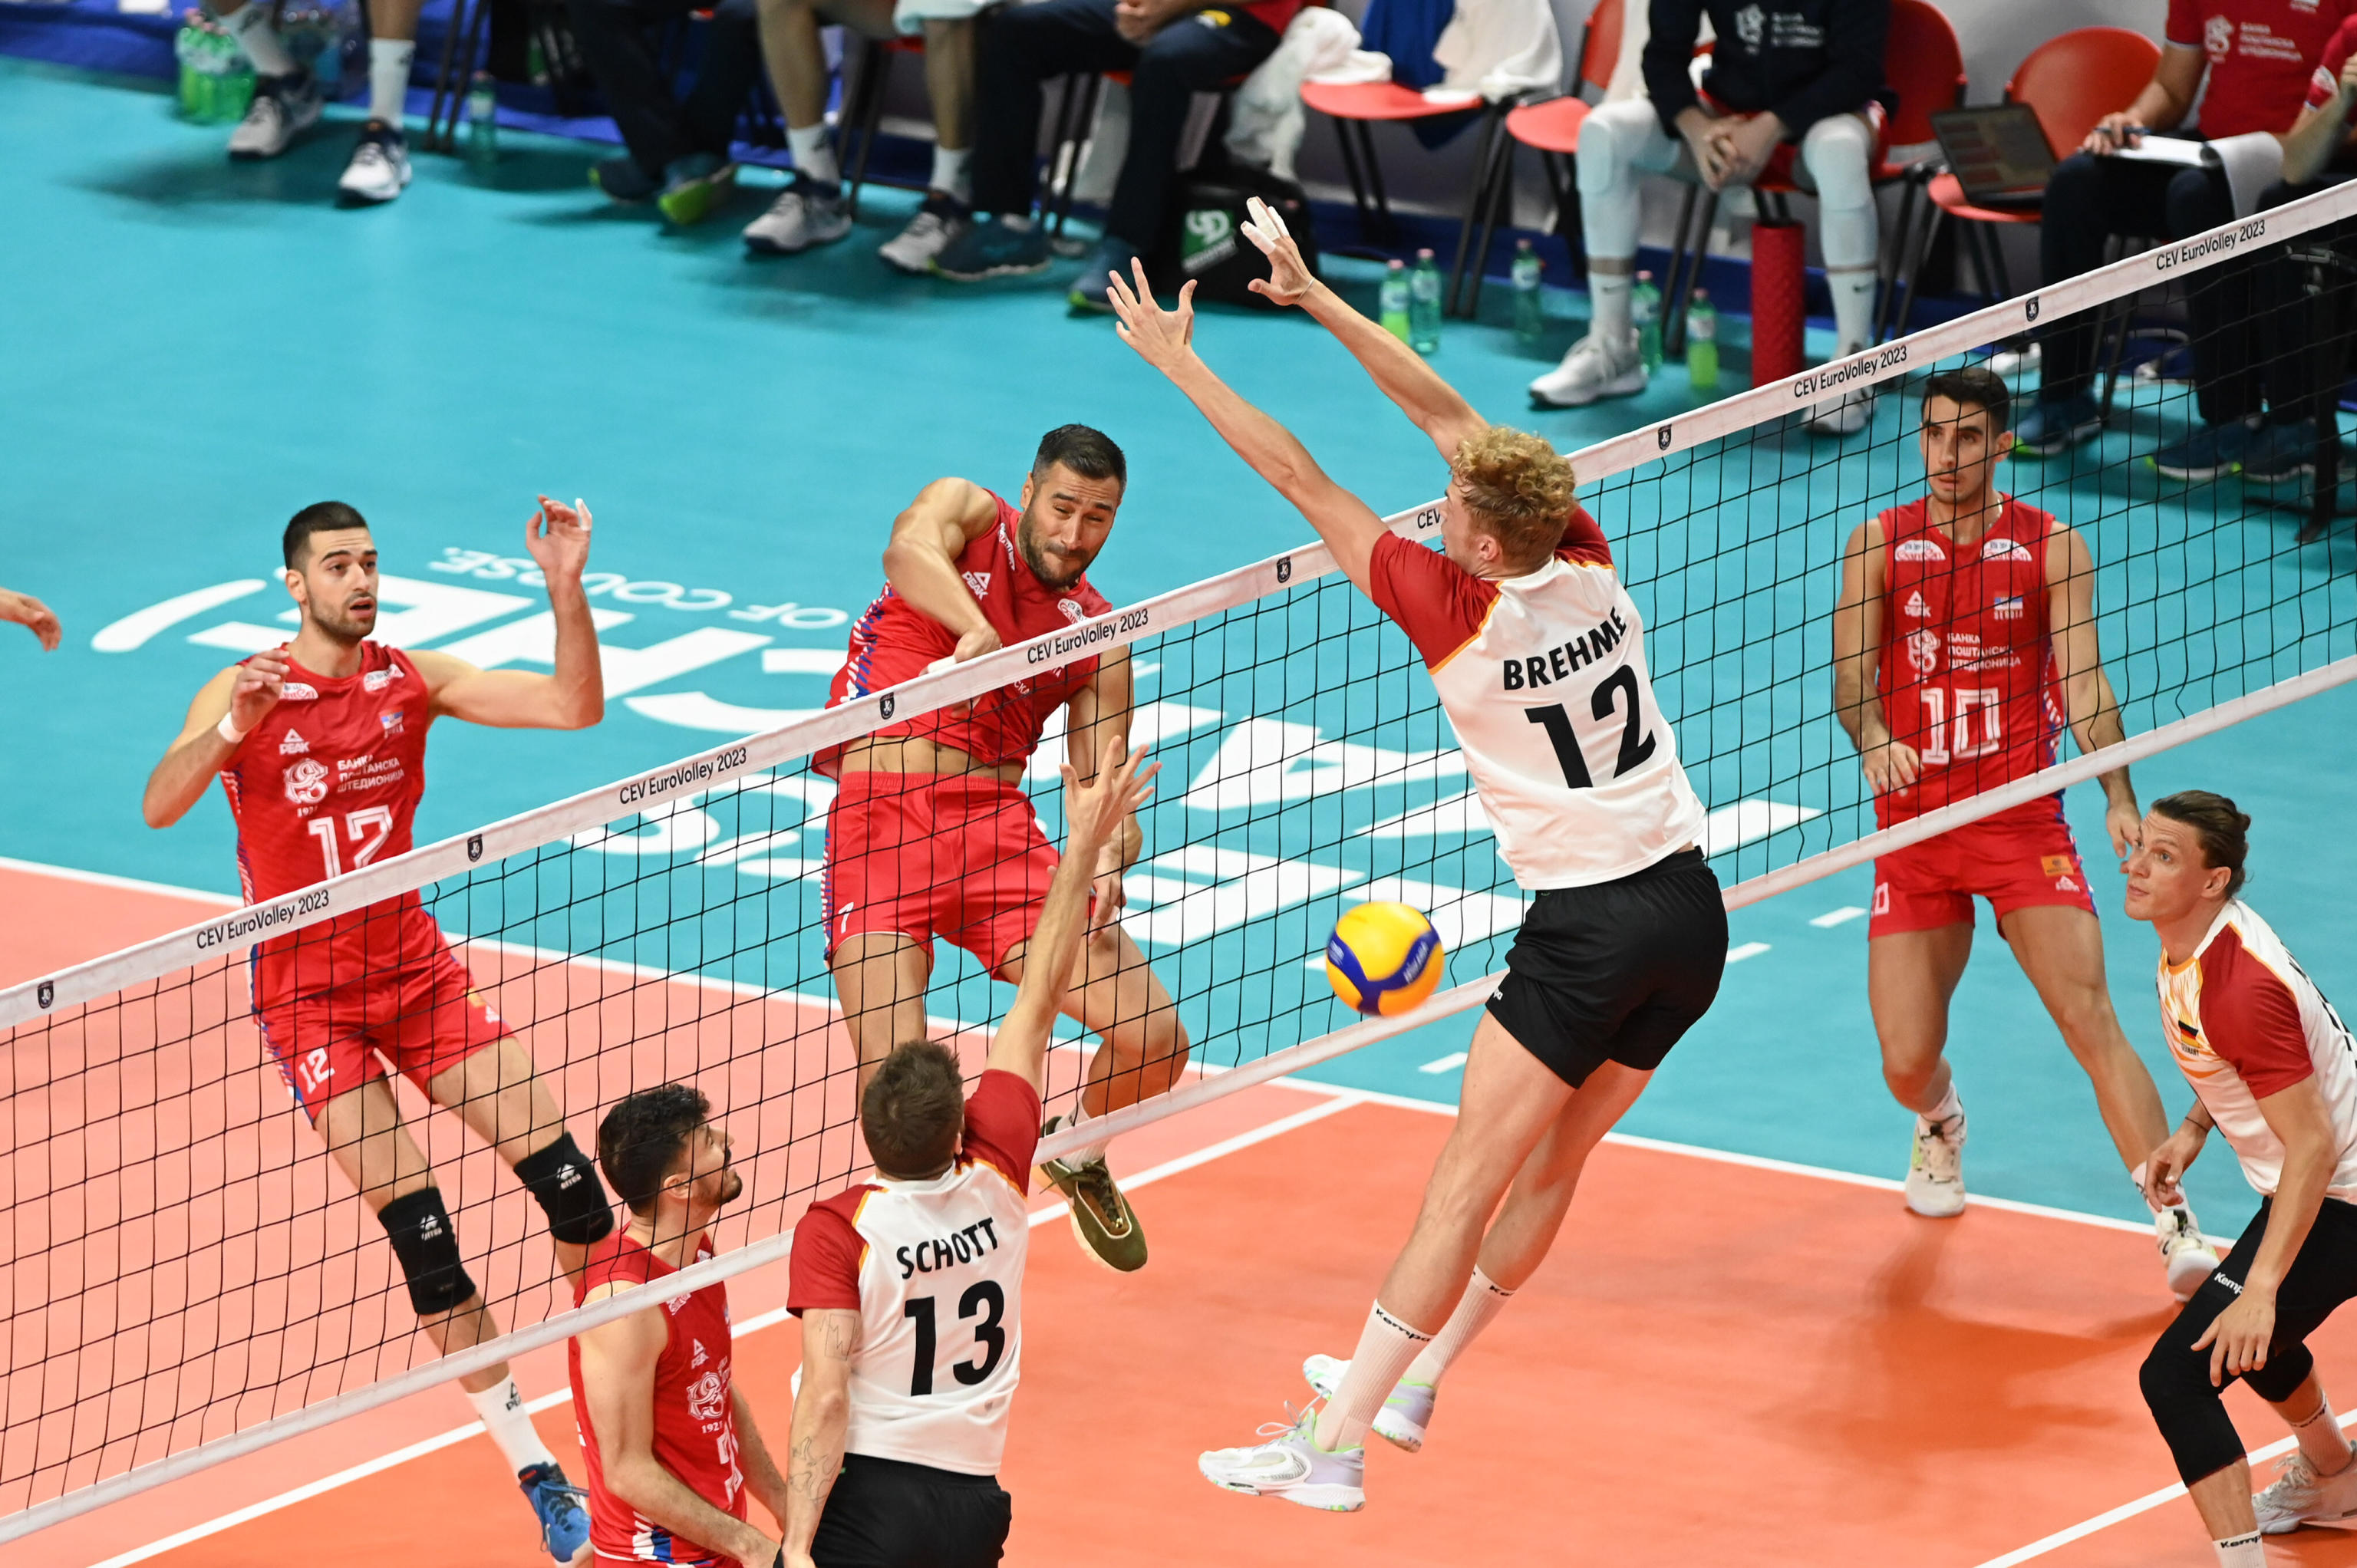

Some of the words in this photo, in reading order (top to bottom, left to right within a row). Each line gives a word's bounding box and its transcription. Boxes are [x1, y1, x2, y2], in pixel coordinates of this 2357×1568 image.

[2156, 249, 2179, 270] CEV
[2182, 232, 2237, 262] EuroVolley
[2240, 219, 2265, 242] 2023
[1794, 376, 1817, 397] CEV
[1821, 358, 1877, 390] EuroVolley
[1881, 346, 1907, 368] 2023
[1417, 508, 1441, 529] CEV
[961, 571, 988, 601] PEAK
[728, 602, 848, 629] OF
[1027, 641, 1052, 664] CEV
[1056, 623, 1116, 654] EuroVolley
[1120, 608, 1149, 633] 2023
[1503, 605, 1627, 690] BREHME
[279, 742, 310, 755] PEAK
[1524, 664, 1656, 789] 12
[1921, 687, 2001, 764] 10
[620, 781, 645, 804] CEV
[649, 763, 713, 795] EuroVolley
[717, 747, 747, 772] 2023
[308, 804, 393, 879] 12
[197, 925, 223, 948] CEV
[228, 905, 295, 938] EuroVolley
[298, 889, 329, 915] 2023
[298, 1048, 335, 1093] 12
[896, 1217, 997, 1280] SCHOTT
[2214, 1272, 2243, 1294] Kemp
[905, 1280, 1005, 1396] 13
[2220, 1534, 2261, 1548] Kemp
